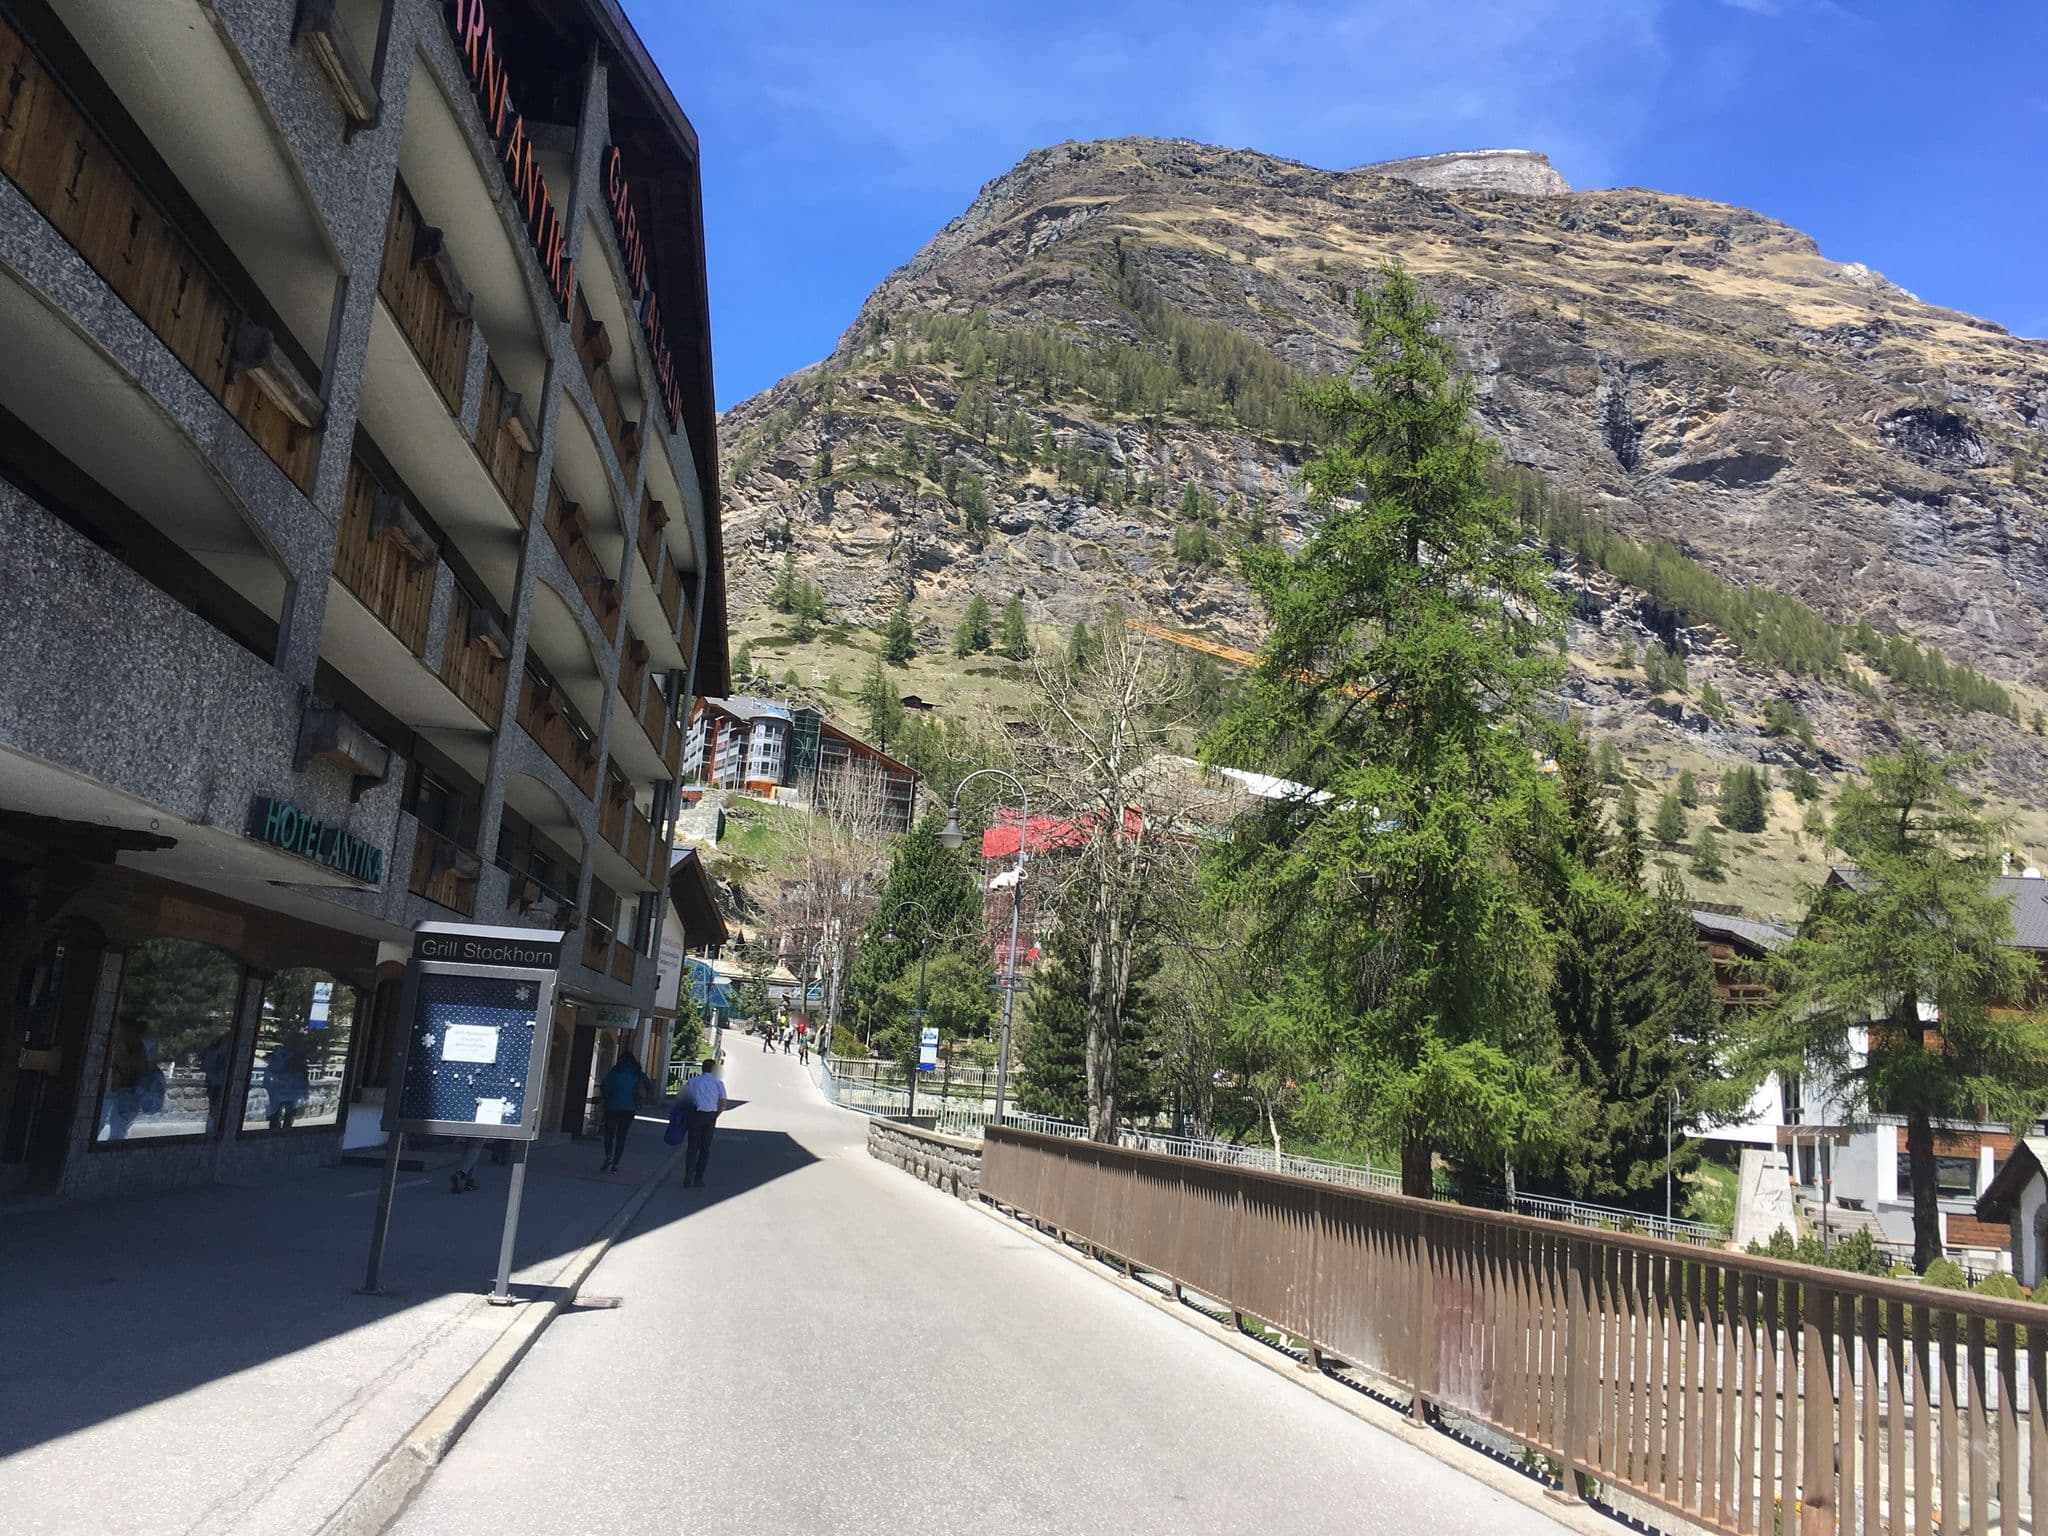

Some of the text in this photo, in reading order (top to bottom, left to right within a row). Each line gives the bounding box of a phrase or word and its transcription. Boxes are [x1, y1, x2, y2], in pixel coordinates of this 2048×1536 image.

[506, 114, 574, 320] ANTIKA
[609, 146, 647, 297] GARNI
[265, 798, 383, 882] HOTEL ANTIKA
[422, 939, 553, 964] Grill Stockhorn
